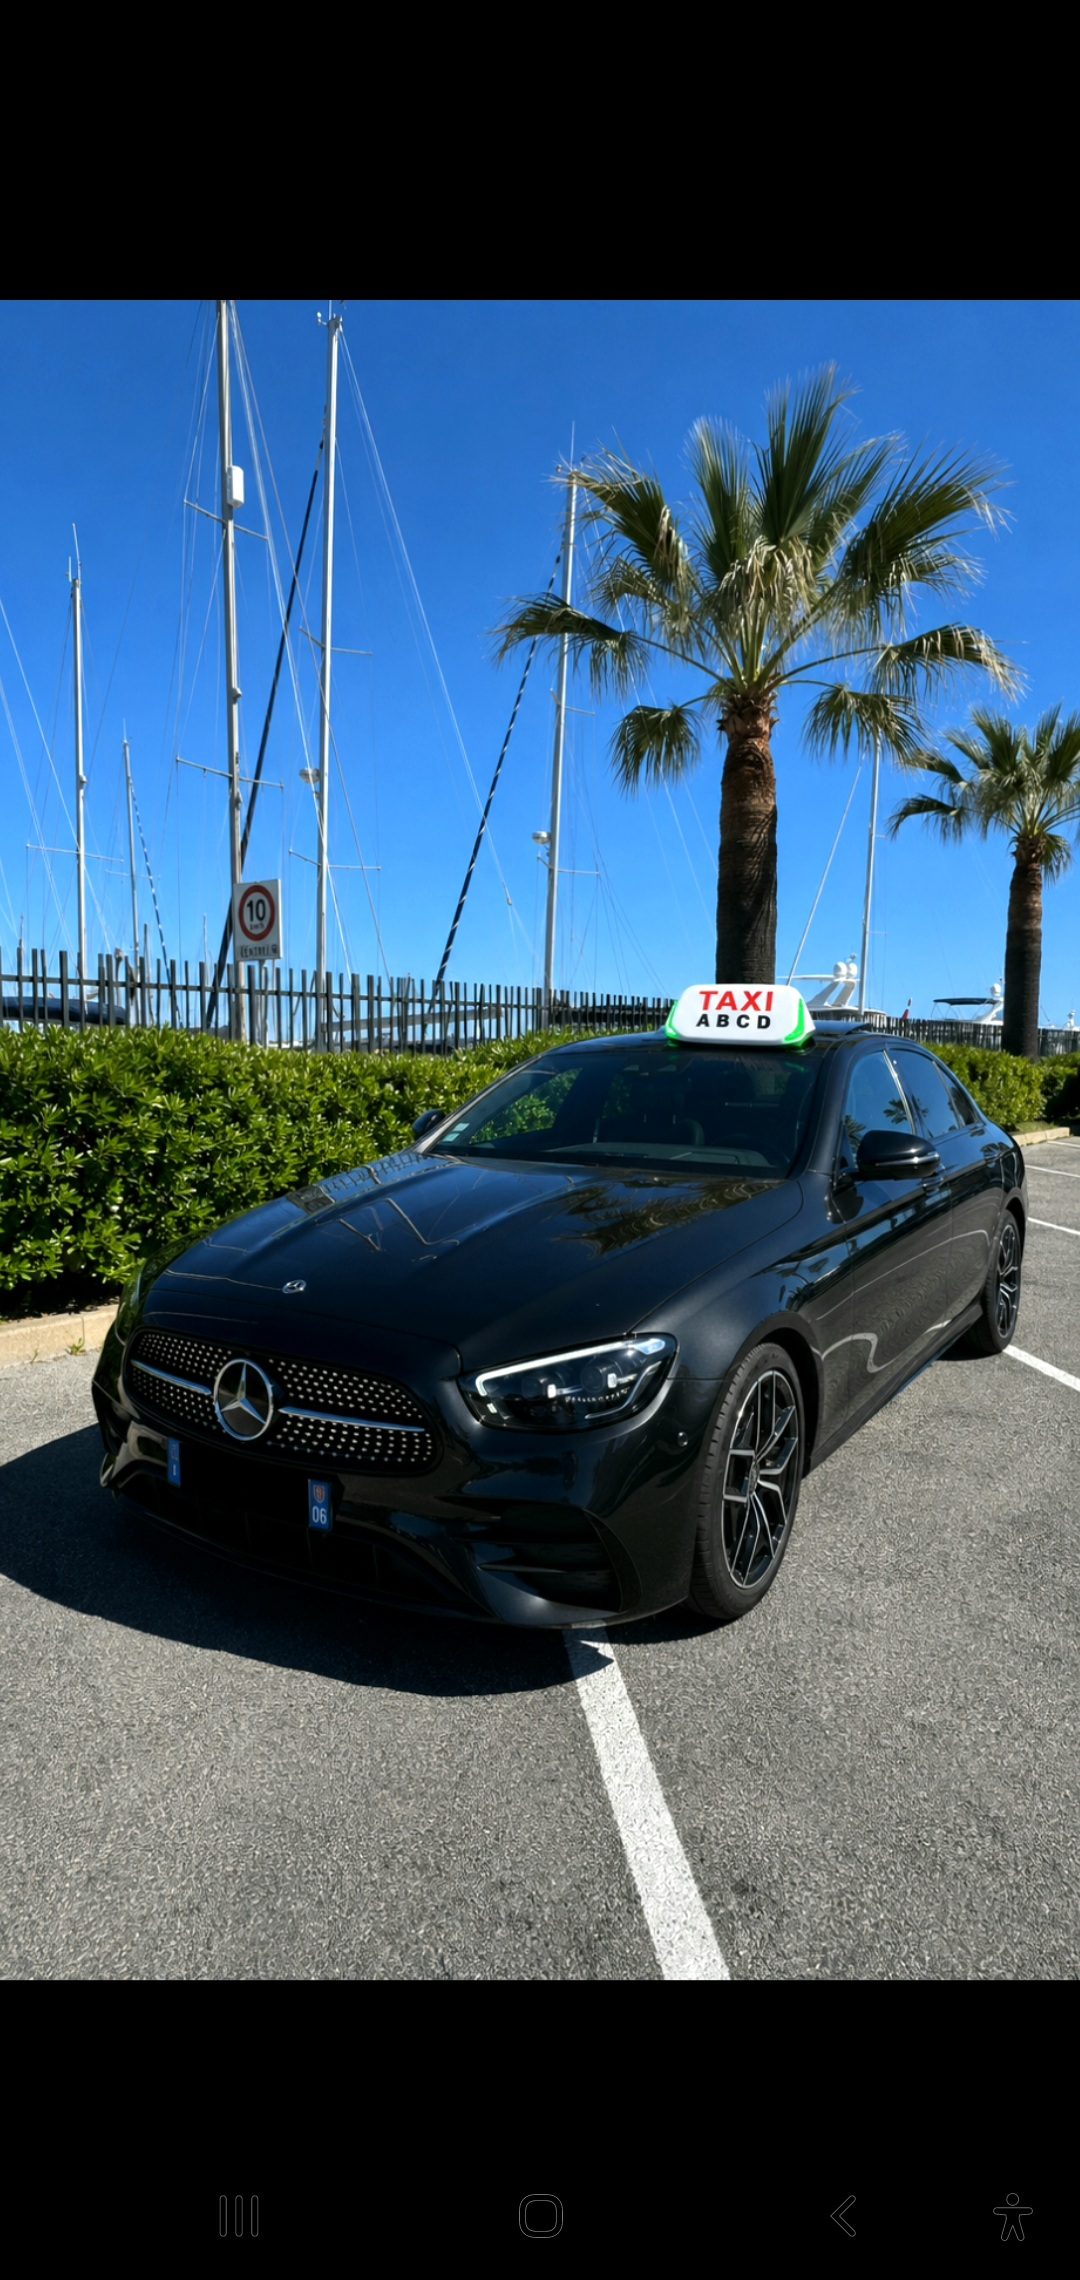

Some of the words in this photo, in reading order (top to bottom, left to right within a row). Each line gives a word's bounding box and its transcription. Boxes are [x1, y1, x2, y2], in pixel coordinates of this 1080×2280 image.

[247, 899, 266, 922] 10
[699, 991, 774, 1011] TAXI
[312, 1505, 328, 1524] 06
